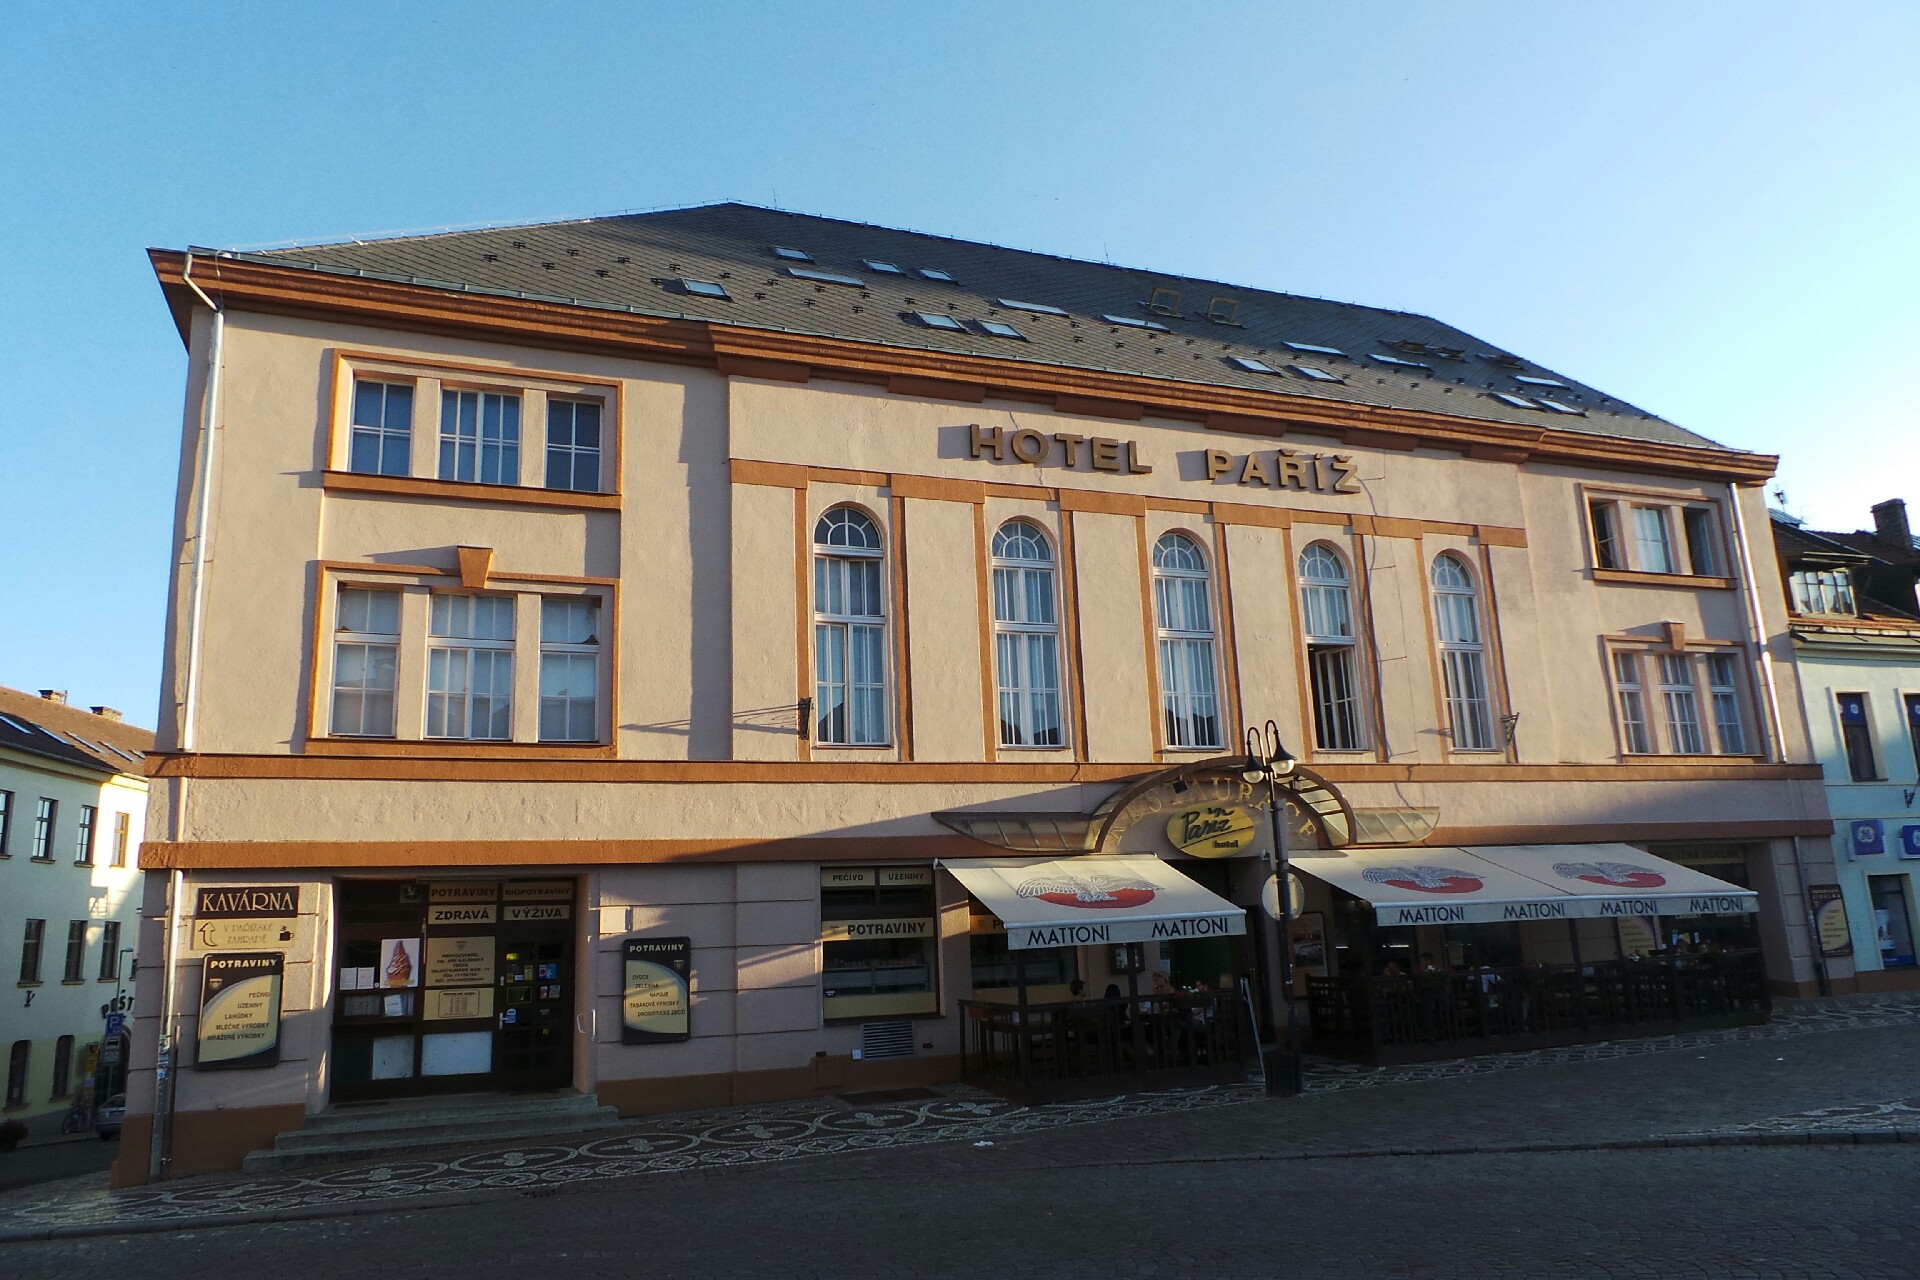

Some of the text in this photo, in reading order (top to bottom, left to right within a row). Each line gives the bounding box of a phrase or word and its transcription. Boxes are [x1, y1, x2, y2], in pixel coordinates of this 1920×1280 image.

[969, 423, 1362, 494] HOTEL PAŘÍŽ
[832, 872, 924, 882] PEČIVO UZENINY
[431, 887, 570, 897] POTRAVINY BIOPOTRAVINY
[202, 889, 294, 911] KAVÁRNA
[434, 907, 562, 921] ZDRAVÁ VÝŽIVA
[1398, 906, 1465, 923] MATTONI
[1503, 902, 1566, 919] MATTONI
[1600, 899, 1658, 915] MATTONI
[1690, 898, 1744, 912] MATTONI
[847, 922, 926, 936] POTRAVINY
[1027, 917, 1229, 946] MATTONI MATTONI
[629, 944, 684, 953] POTRAVINY
[210, 959, 277, 969] POTRAVINY
